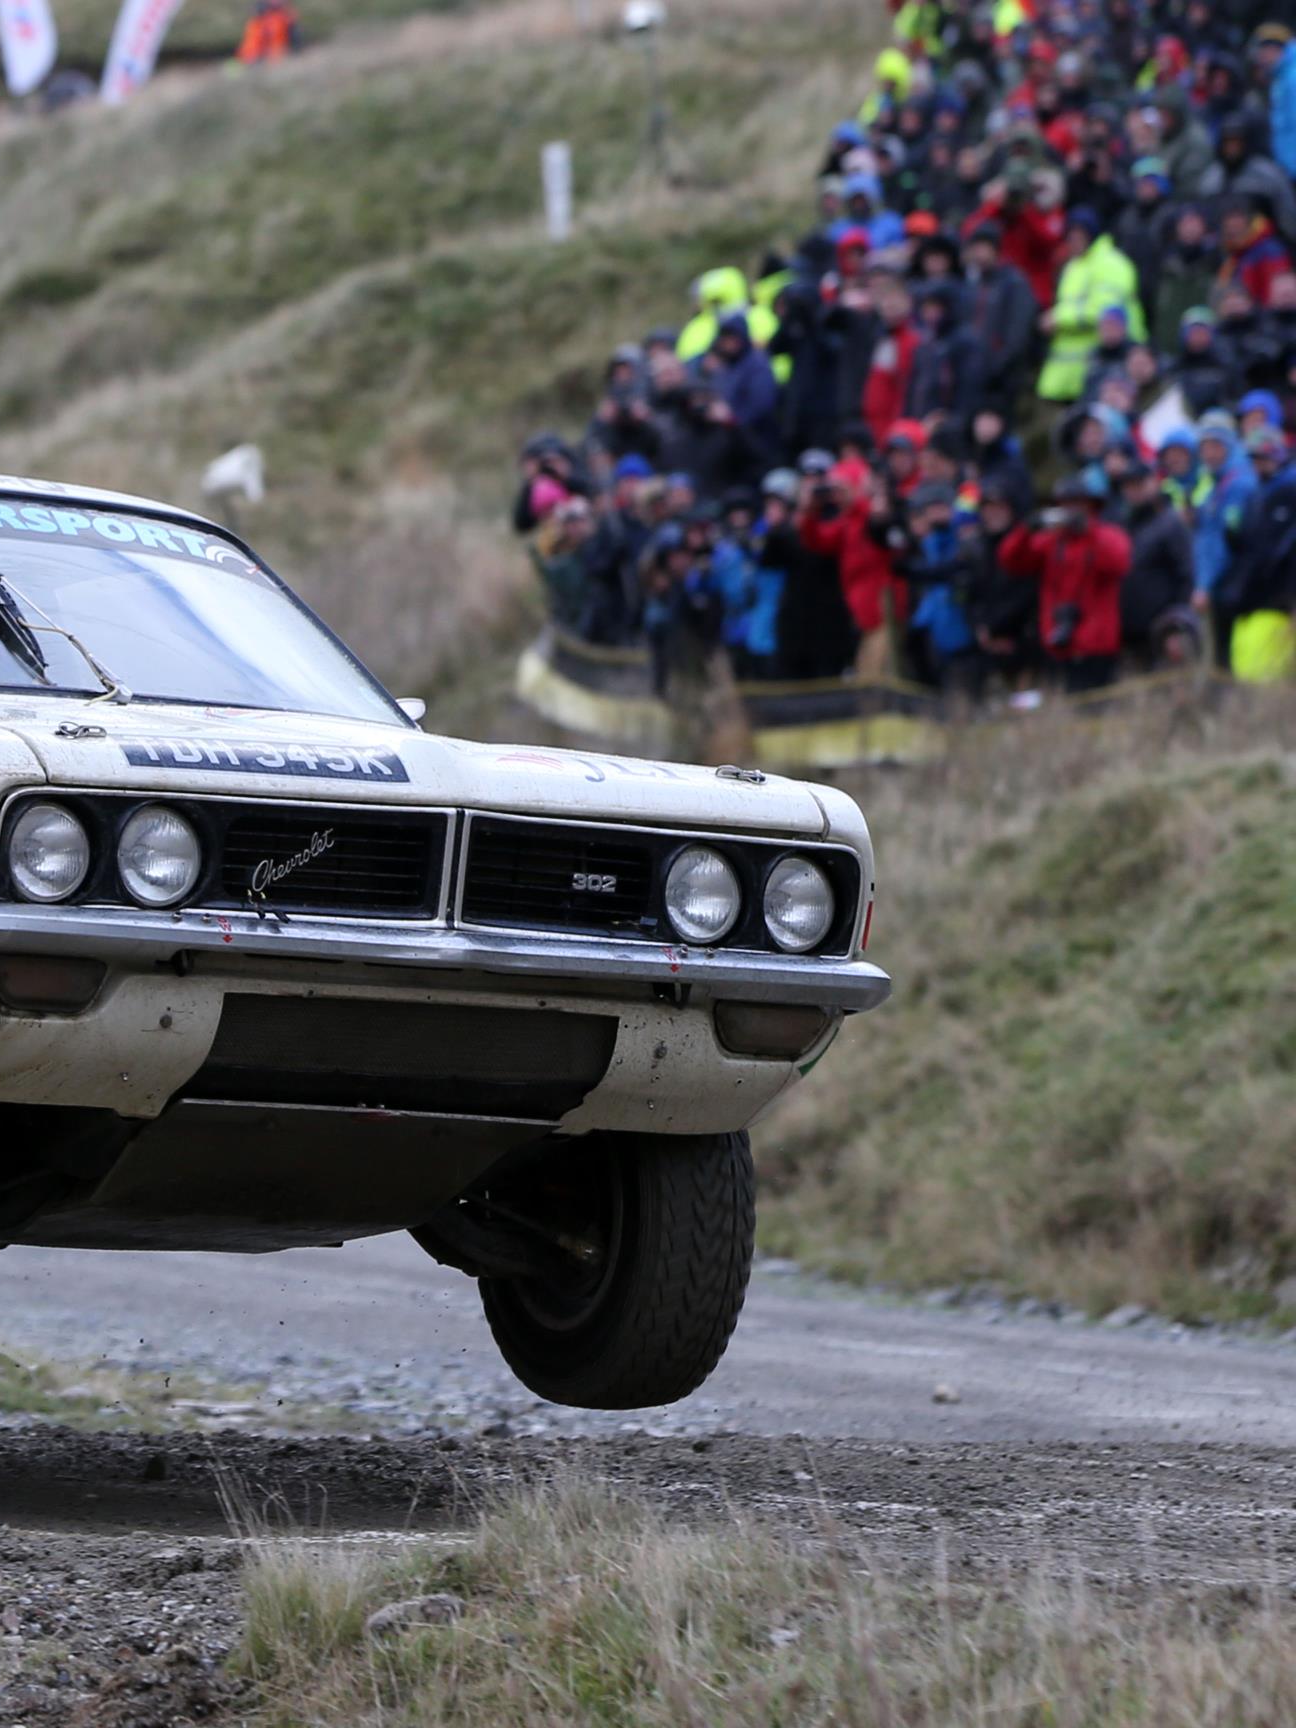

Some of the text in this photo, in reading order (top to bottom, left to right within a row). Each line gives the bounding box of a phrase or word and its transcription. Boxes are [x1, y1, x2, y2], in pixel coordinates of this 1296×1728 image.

[248, 742, 393, 775] 345K
[252, 828, 335, 892] Chevrolet
[572, 873, 616, 892] 302
